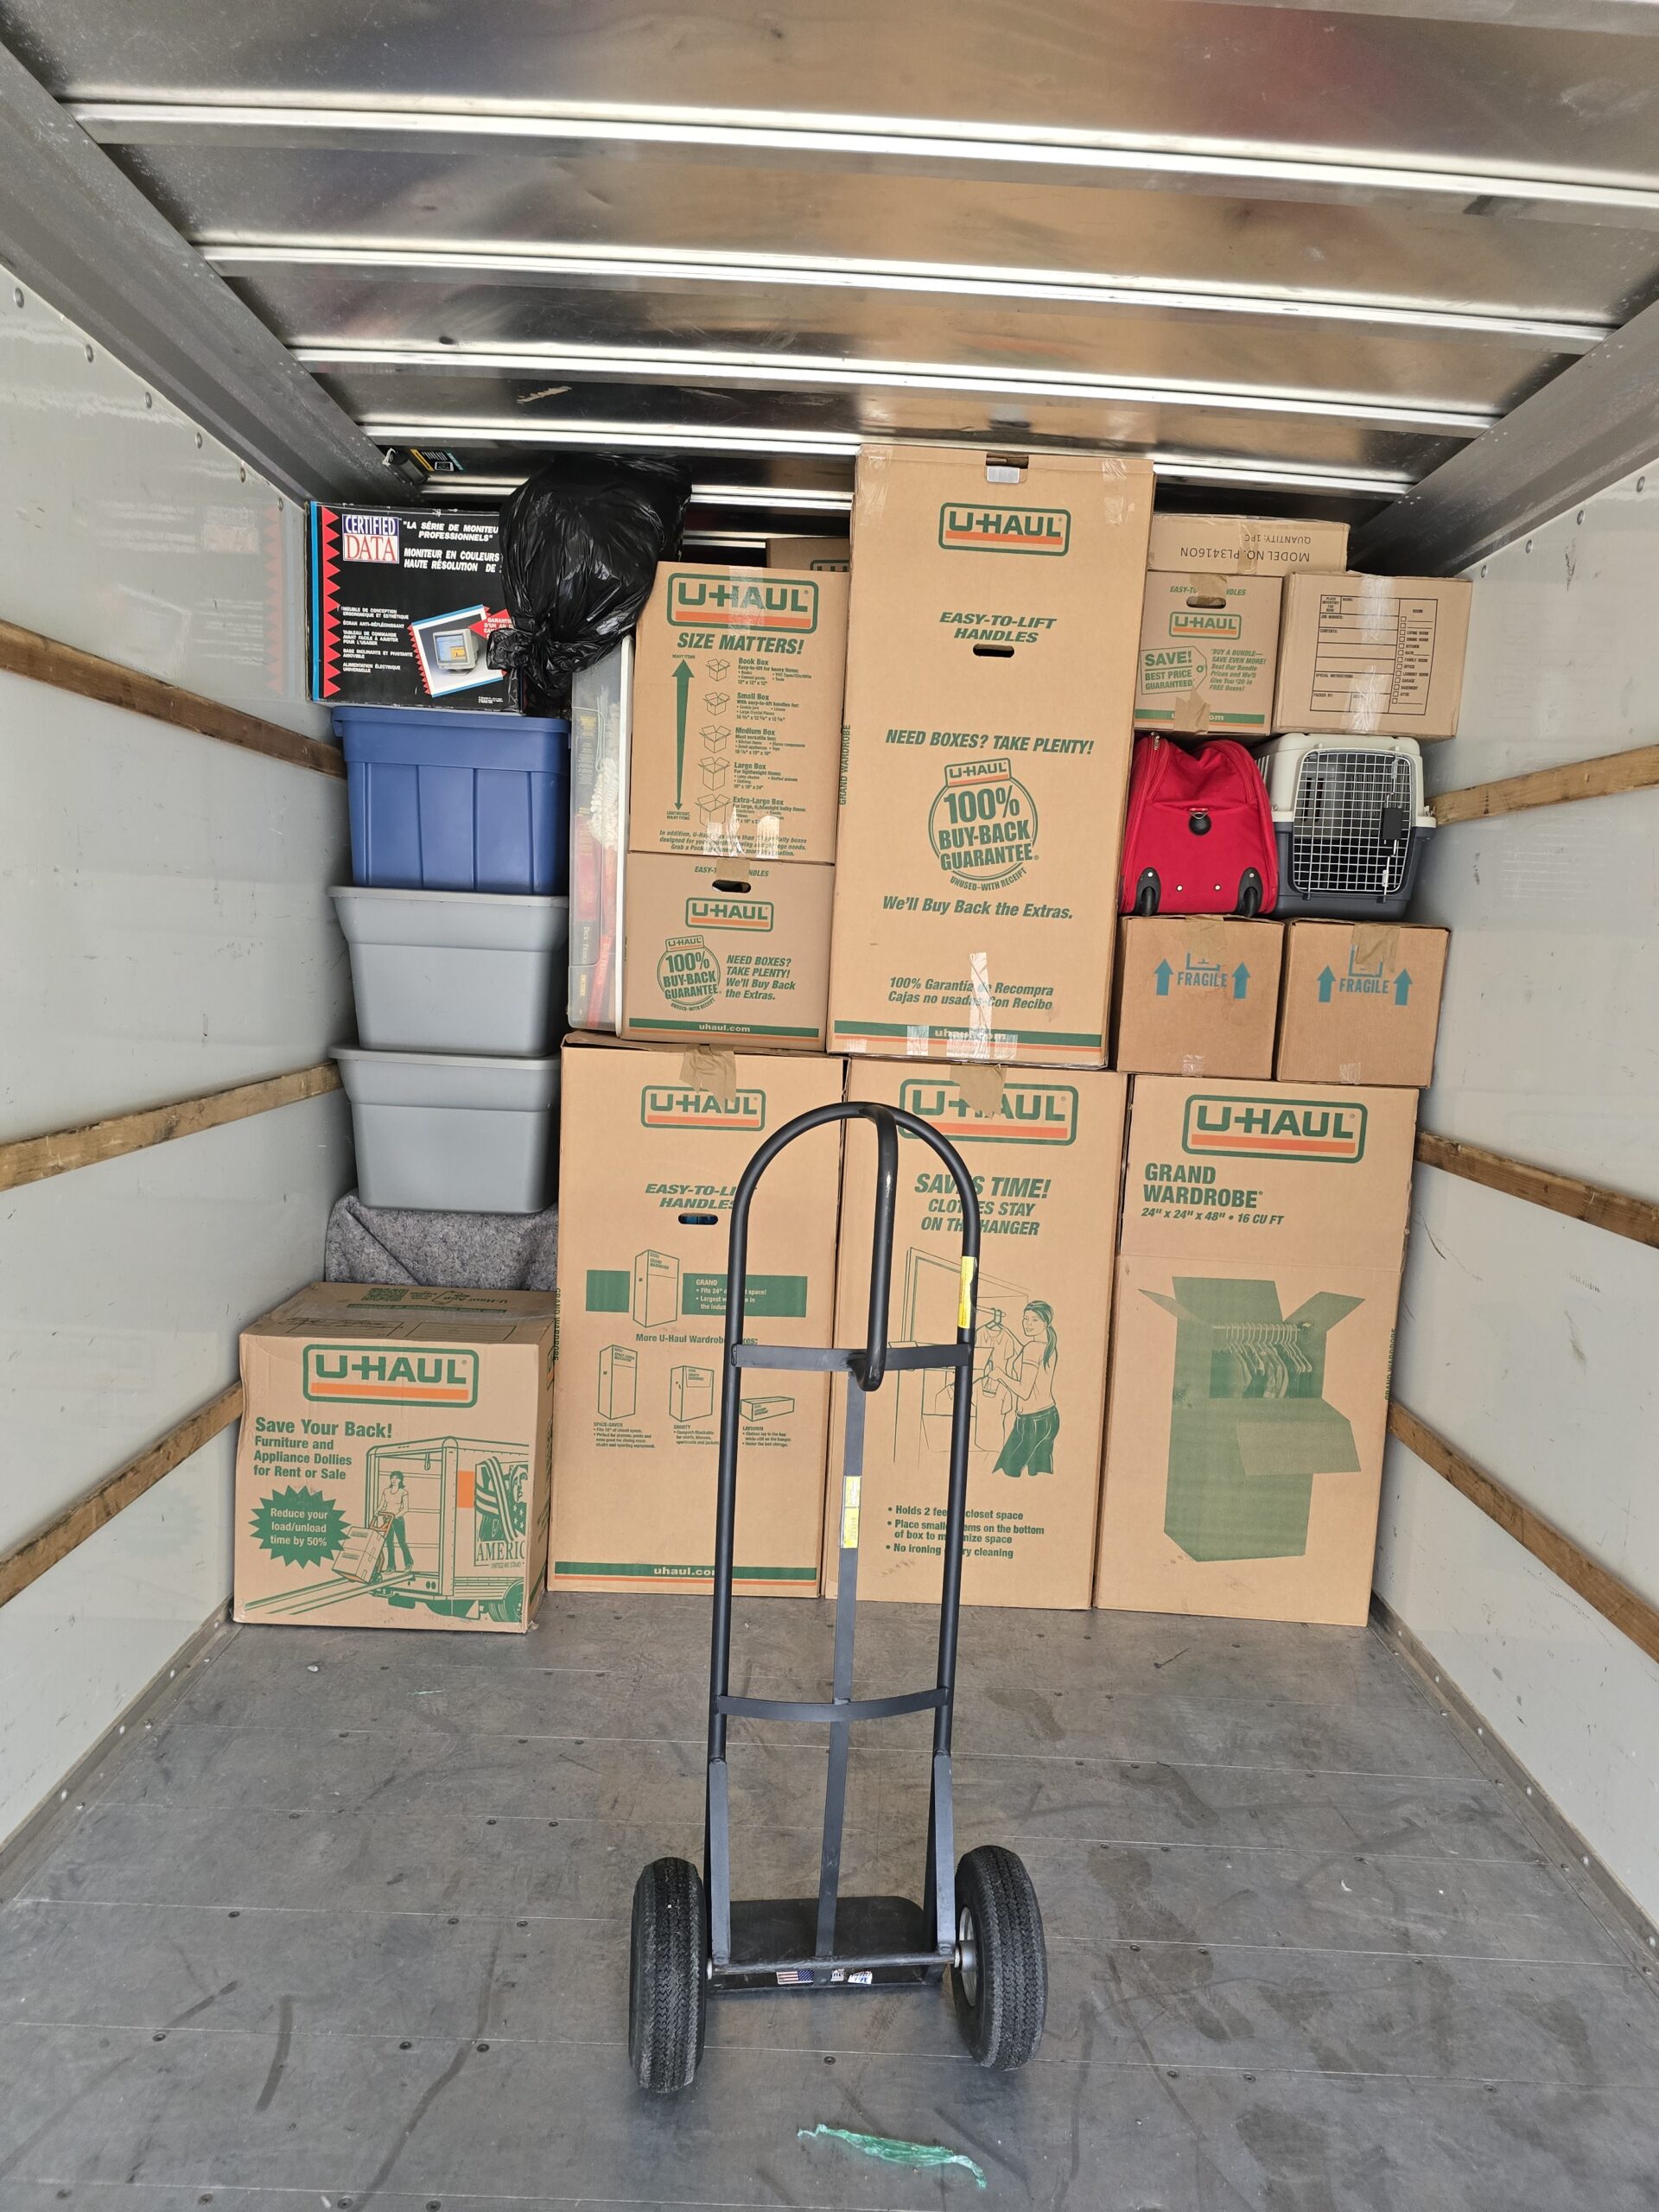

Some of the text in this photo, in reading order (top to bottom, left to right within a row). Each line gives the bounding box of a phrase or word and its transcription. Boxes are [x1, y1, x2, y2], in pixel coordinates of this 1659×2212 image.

[346, 515, 396, 536] CERTIFIED
[421, 521, 445, 531] SÉRIE
[949, 511, 1061, 537] U-HAUL
[418, 531, 493, 542] PROFESSIONNELS"
[1244, 534, 1312, 544] QUANTITY: 1PC
[346, 535, 396, 562] DATA
[404, 548, 499, 562] MONITEUR EN COULEURS
[1243, 550, 1264, 560] NO.
[1267, 551, 1310, 562] MODEL
[404, 559, 496, 573] HAUTE RÉSOLUTION DE
[678, 582, 808, 613] U-HAUL
[938, 611, 1058, 630] EASY-TO-LIFT
[1175, 615, 1236, 630] U-HAUL
[677, 632, 804, 655] SIZE MATTERS!
[953, 628, 1039, 644] HANDLES
[1145, 651, 1192, 666] SAVE!
[1145, 670, 1192, 681] BEST PRICE
[1146, 679, 1192, 690] GUARANTEED
[841, 724, 850, 773] WARDROBE
[885, 728, 1095, 754] NEED BOXES? TAKE PLENTY!
[950, 762, 1007, 778] U-HAUL
[733, 796, 771, 806] Extra-Large
[944, 785, 1020, 824] 100%
[938, 819, 1030, 850] BUY-BACK
[940, 843, 1033, 871] GUARANTEE
[1001, 868, 1027, 887] RECEIPT
[691, 902, 768, 921] U-HAUL
[882, 895, 1074, 919] We'll Buy Back the Extras.
[668, 938, 702, 946] U-HAUL
[581, 944, 589, 965] FRANCI
[665, 950, 709, 973] 100%
[727, 955, 791, 967] NEED BOXES?
[663, 970, 716, 988] BUY-BACK
[727, 967, 791, 978] TAKE PLENTY!
[1177, 971, 1228, 988] FRAGILE
[664, 984, 718, 1000] GUARANTEE
[726, 978, 796, 990] We'll Buy Back
[890, 976, 1053, 997] 100% Garantía Recompra
[1338, 978, 1389, 995] FRAGILE
[725, 989, 775, 1001] the Extras.
[888, 991, 1053, 1010] Cajas no Recibo
[699, 1024, 750, 1033] uhaul.com
[650, 1093, 758, 1116] U-HAUL
[1197, 1105, 1354, 1140] U-HAUL
[1145, 1163, 1217, 1185] GRAND
[914, 1173, 1051, 1198] SAVS TIME!
[1143, 1185, 1258, 1208] WARDROBE
[998, 1202, 1036, 1217] STAY
[1141, 1207, 1162, 1217] 24"
[1173, 1210, 1193, 1219] 24"
[1205, 1211, 1225, 1221] 48"
[1237, 1213, 1250, 1223] 16
[1253, 1214, 1268, 1224] CU
[1269, 1216, 1284, 1224] FT
[921, 1217, 1040, 1235] ON TH HANGER
[659, 1334, 687, 1343] U-Haul
[315, 1354, 467, 1384] U-HAUL
[256, 1417, 392, 1438] Save Your Back!
[255, 1435, 334, 1450] Furniture and
[254, 1451, 352, 1465] Appliance Dollies
[254, 1465, 346, 1479] for Rent or Sale
[270, 1508, 327, 1520] Reduce your
[896, 1505, 1023, 1521] Holds 2 closet space
[271, 1522, 327, 1533] load/unload
[895, 1519, 919, 1529] Place
[997, 1524, 1011, 1533] the
[1013, 1525, 1045, 1535] bottom
[270, 1535, 327, 1547] time by 50%
[906, 1531, 923, 1540] box
[985, 1535, 1013, 1544] space
[893, 1543, 1014, 1559] No ironing cleaning
